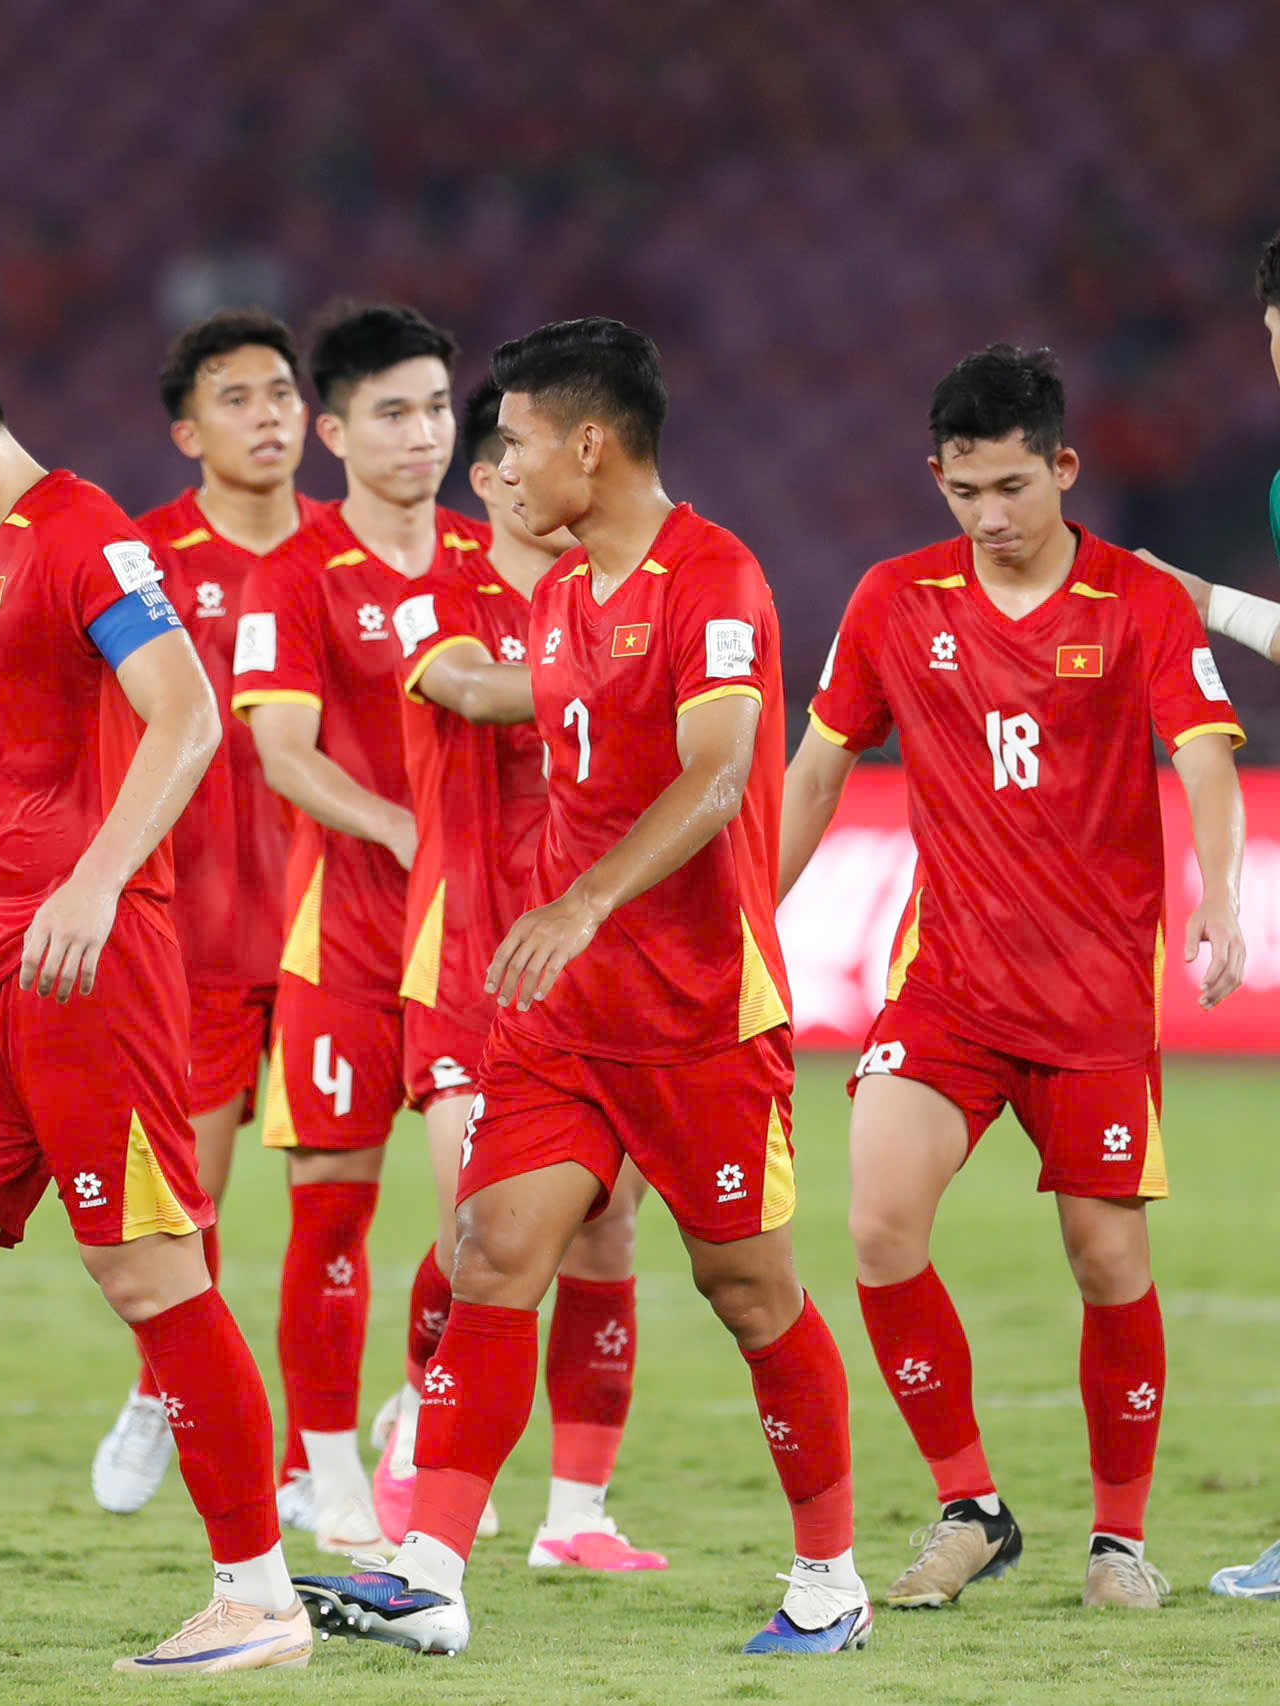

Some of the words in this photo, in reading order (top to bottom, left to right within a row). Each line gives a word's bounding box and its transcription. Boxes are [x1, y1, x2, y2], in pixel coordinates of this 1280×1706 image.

[563, 697, 591, 784] 7
[985, 710, 1040, 792] 18
[312, 1034, 353, 1117] 4
